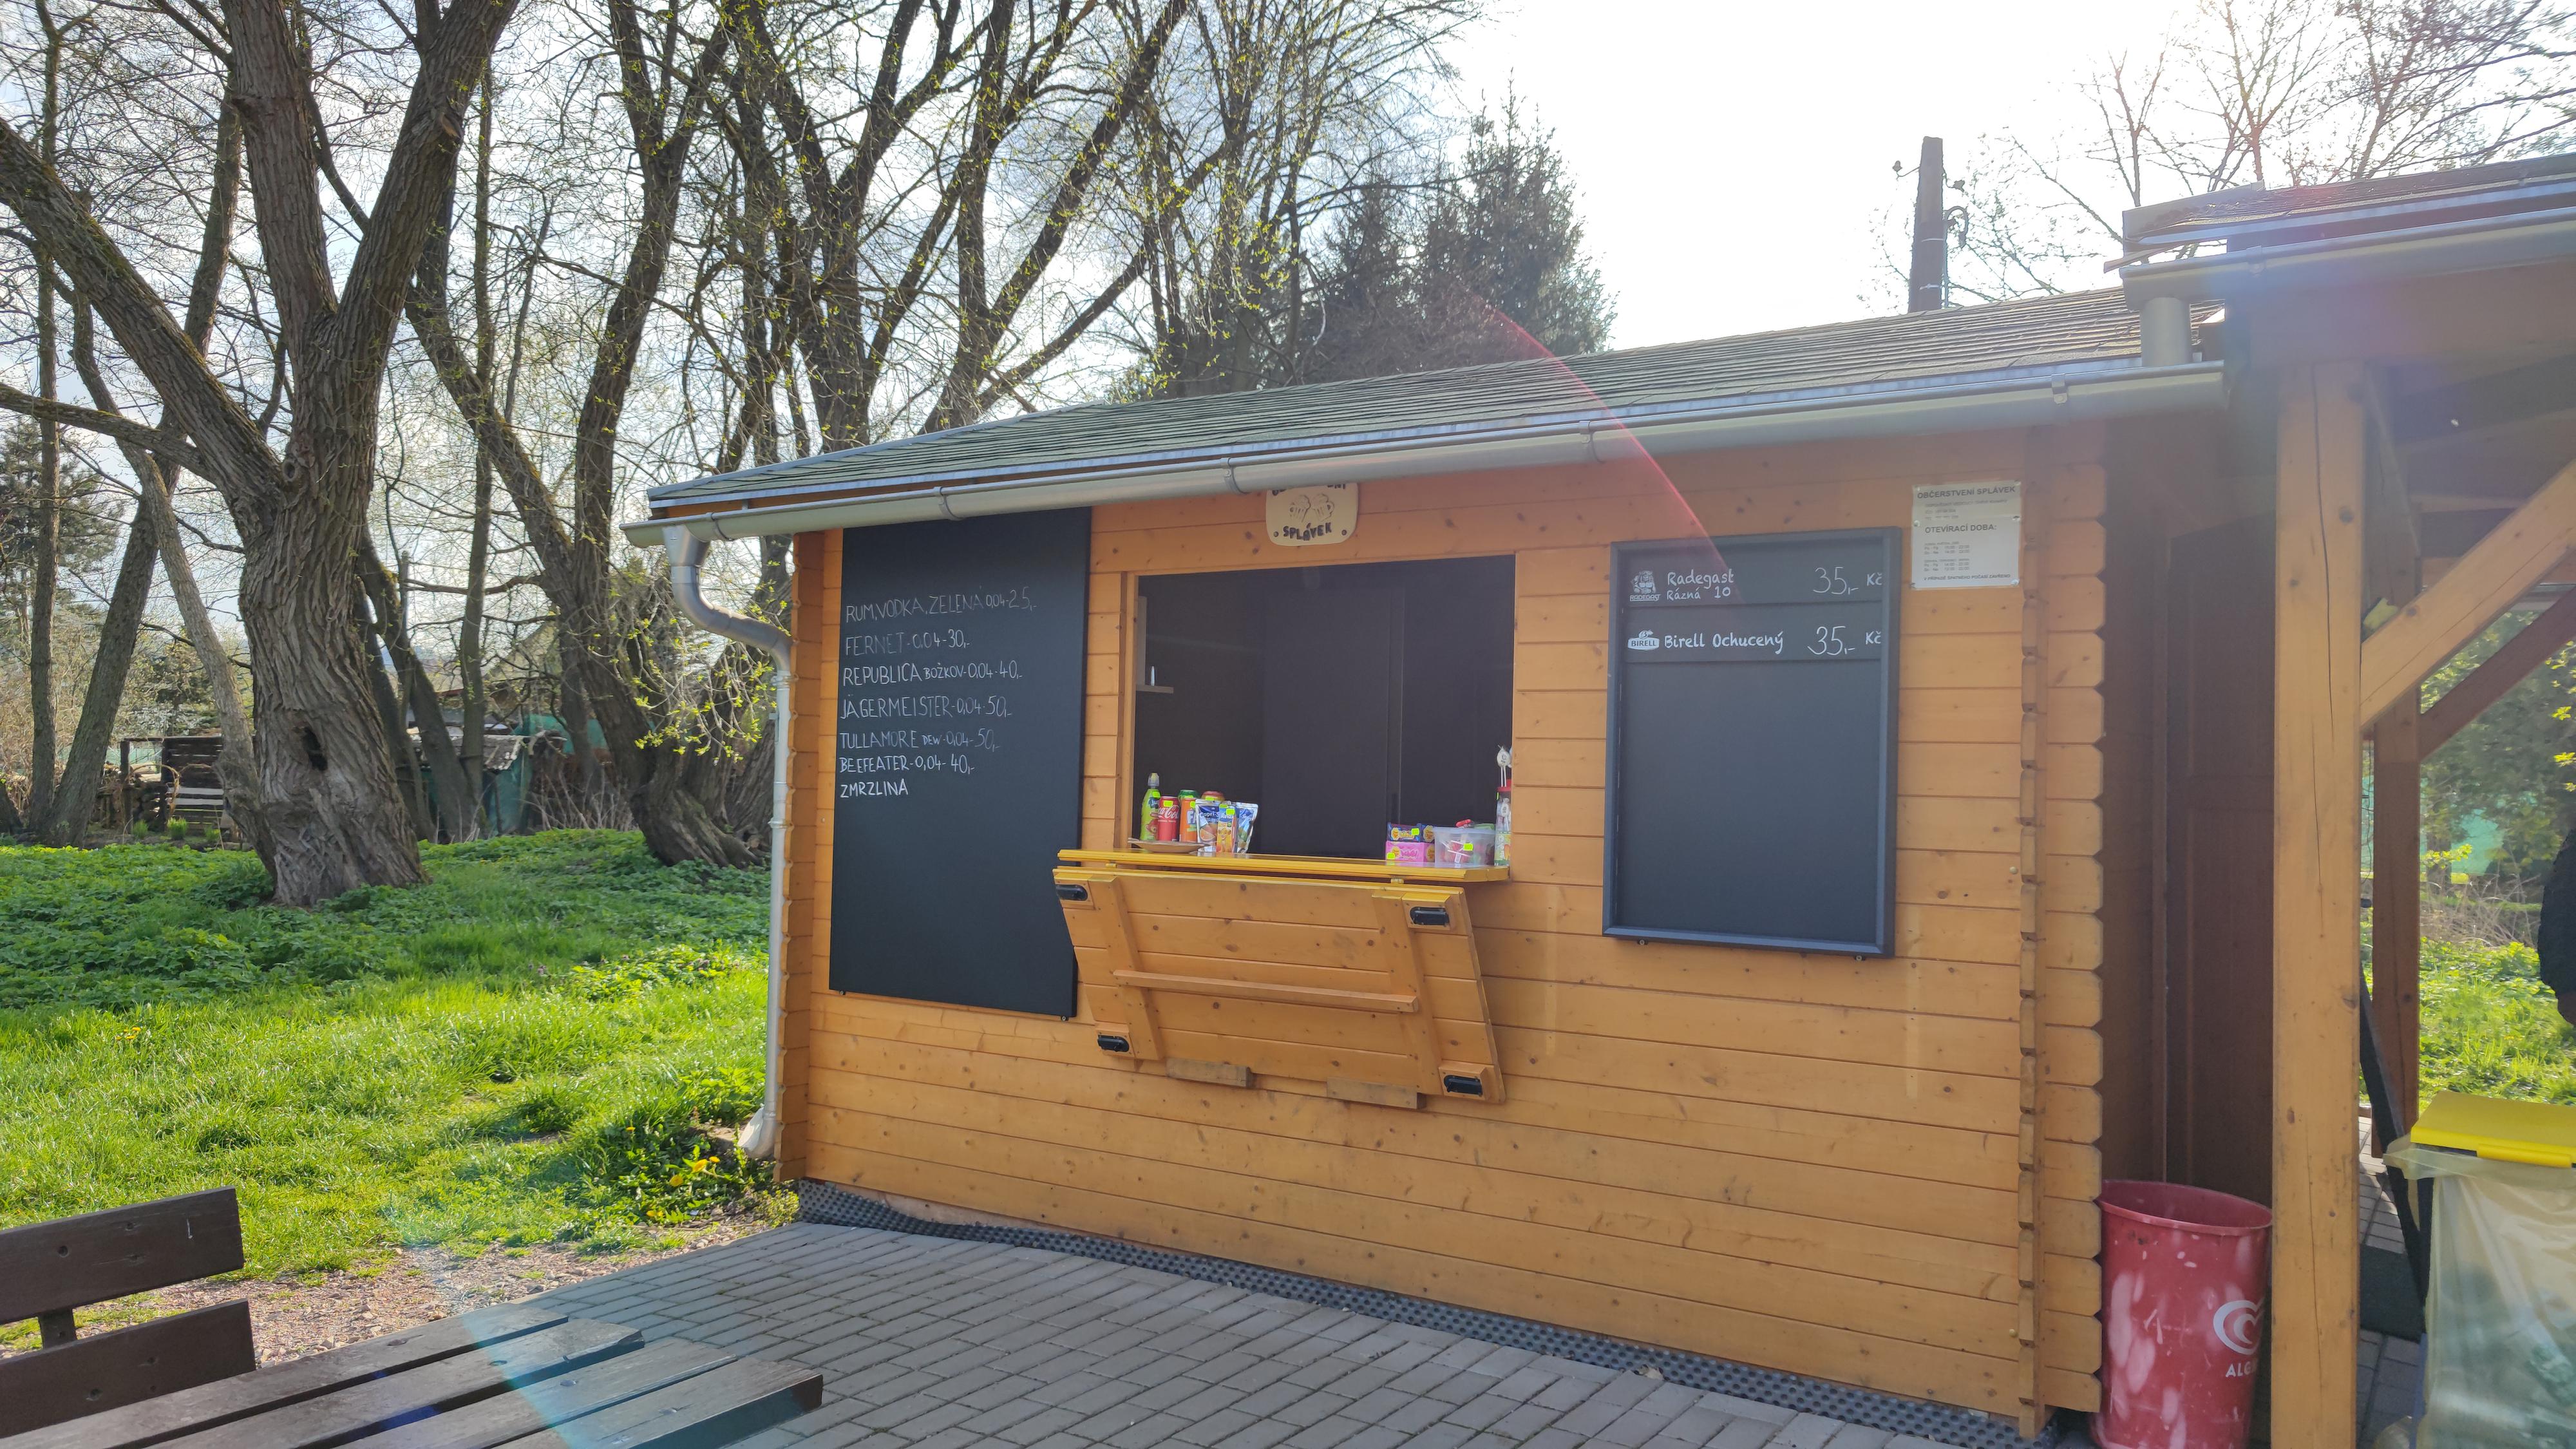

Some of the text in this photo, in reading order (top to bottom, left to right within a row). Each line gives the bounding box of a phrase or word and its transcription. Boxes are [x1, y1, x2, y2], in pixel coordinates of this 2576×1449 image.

[1917, 486, 2015, 499] OBČERSTVENÍ SPLÁVEK
[1283, 522, 1332, 541] SPLÁVEK
[1925, 524, 1968, 534] OTEVÍRACÍ
[1667, 569, 1734, 589] Radegast
[1866, 573, 1882, 586] Kč
[1667, 585, 1731, 601] Rázná 10
[1664, 630, 1784, 654] Birell Ochucený
[1866, 630, 1882, 645] Kč
[843, 663, 923, 687] REPUBLICA
[840, 729, 919, 748] TULLAMORE
[840, 778, 909, 798] ZMRZLINA
